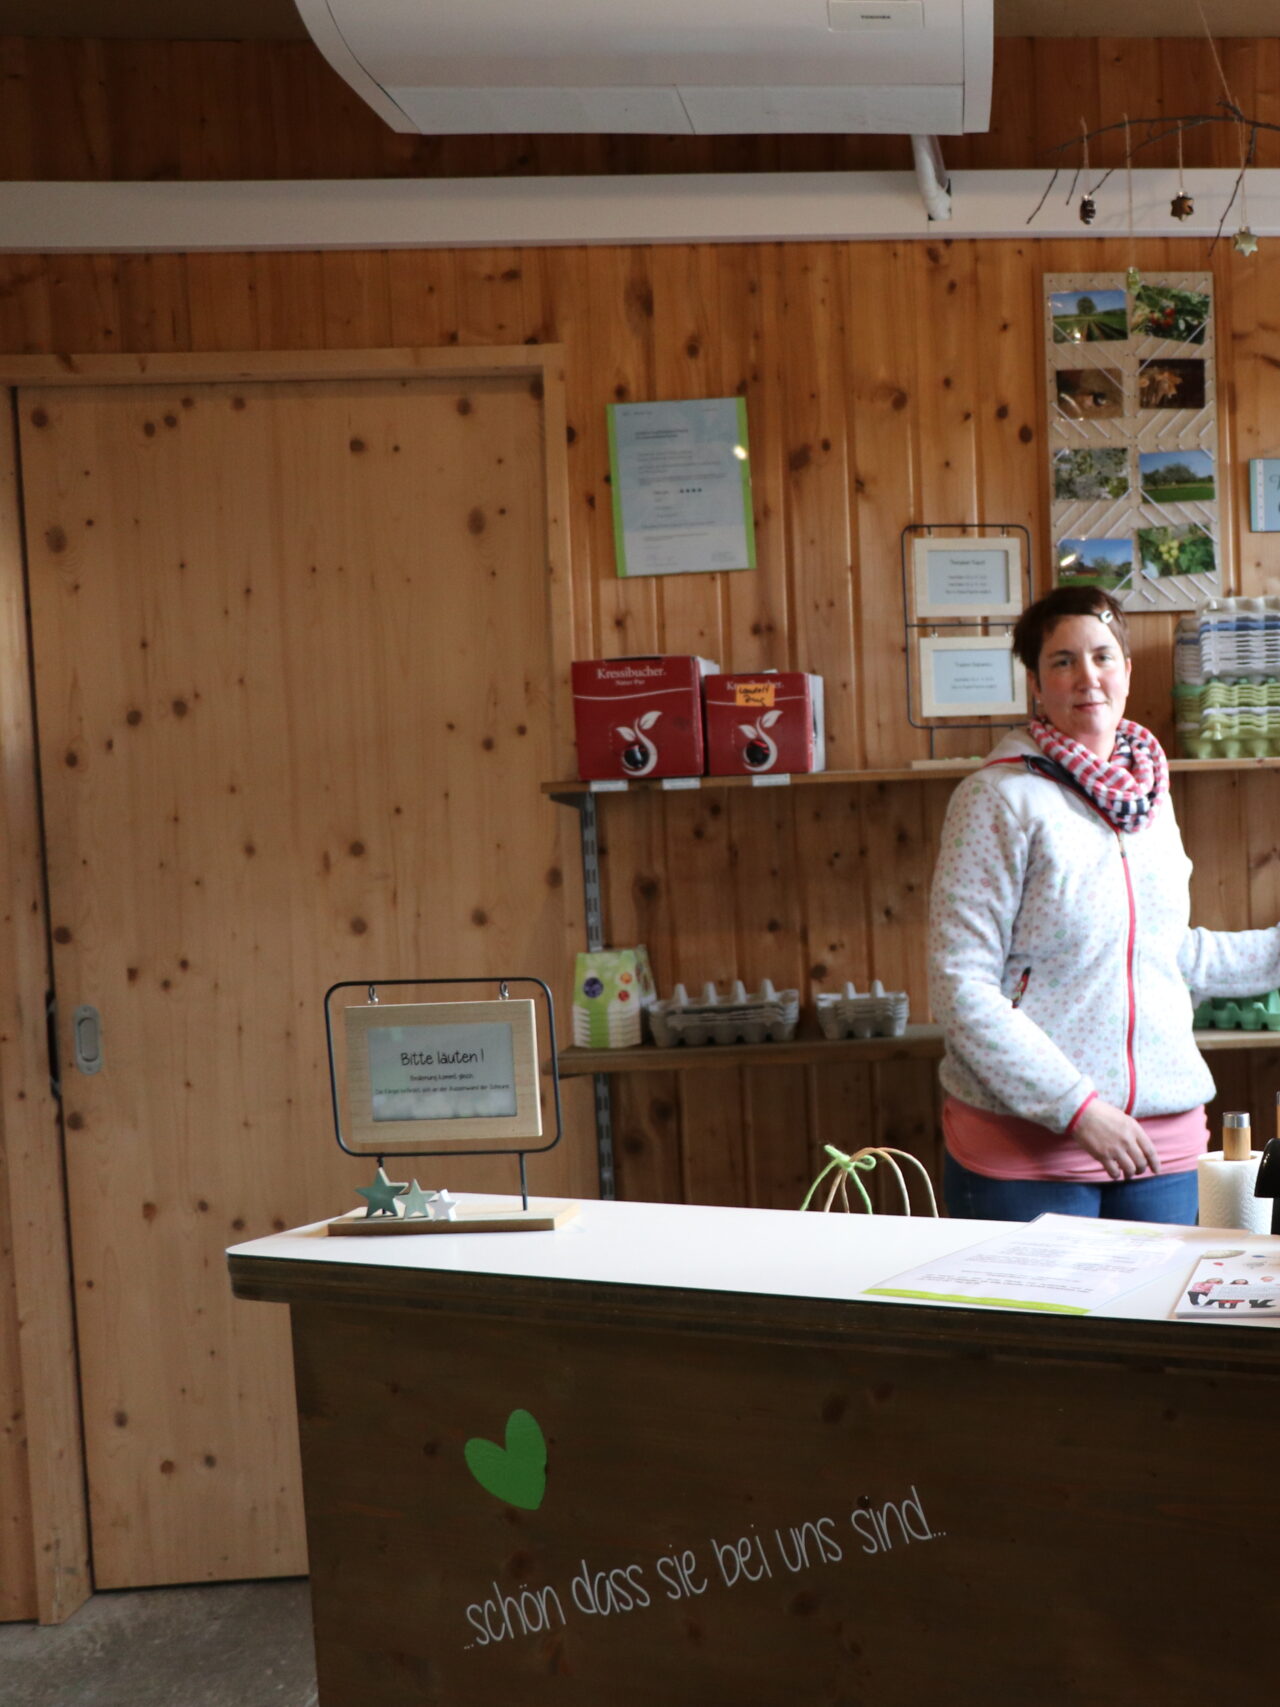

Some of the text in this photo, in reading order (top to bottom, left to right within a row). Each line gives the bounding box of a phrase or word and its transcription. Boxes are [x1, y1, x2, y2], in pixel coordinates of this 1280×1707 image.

[400, 1050, 434, 1067] Bitte
[571, 1559, 651, 1616] dass
[656, 1544, 708, 1600] sie
[711, 1523, 773, 1587] bei
[775, 1516, 843, 1573] uns
